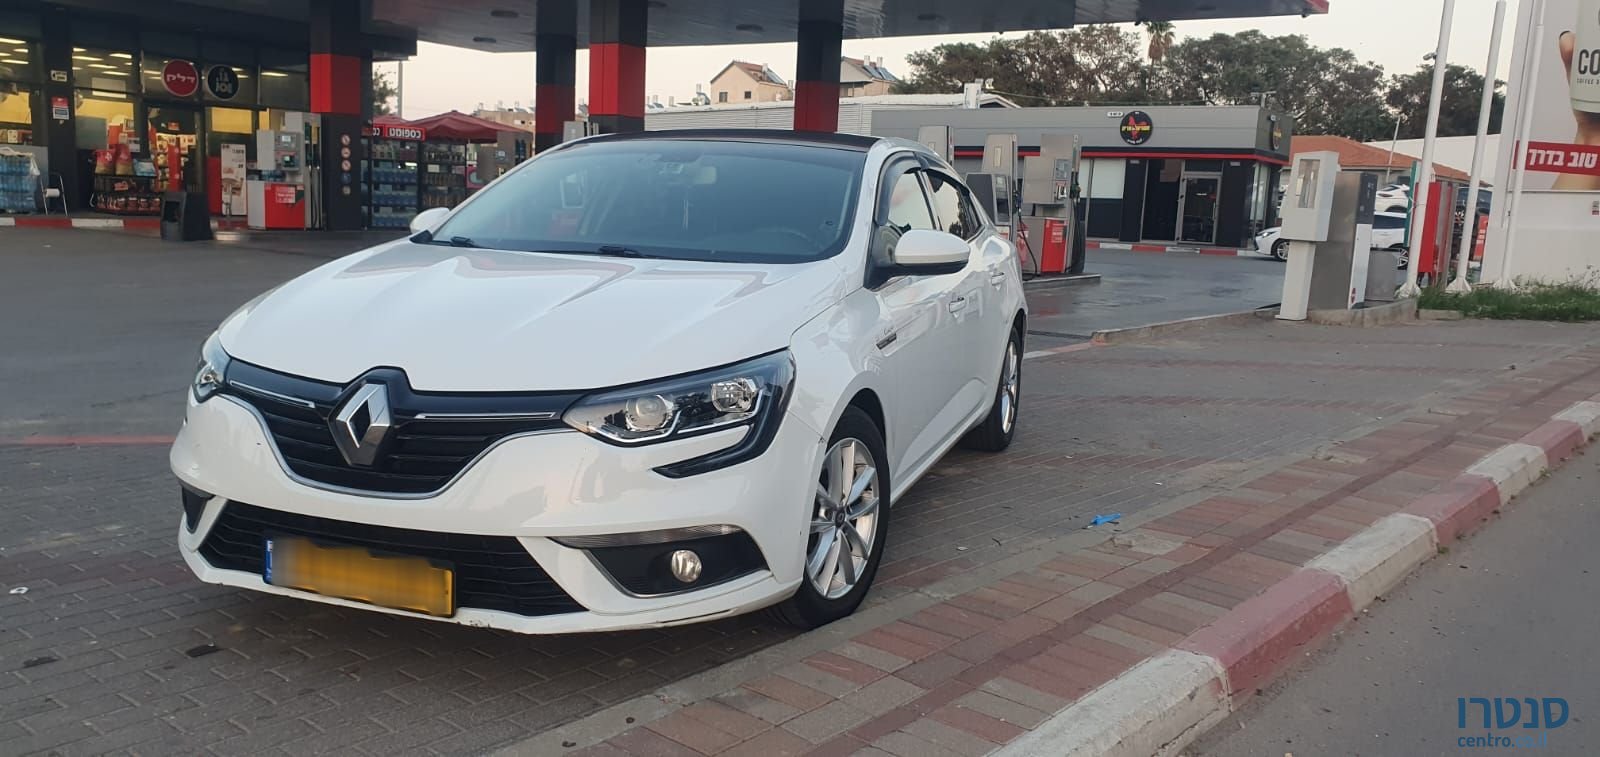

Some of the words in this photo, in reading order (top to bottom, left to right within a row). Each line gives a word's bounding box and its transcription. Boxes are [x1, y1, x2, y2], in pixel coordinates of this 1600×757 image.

[166, 73, 196, 84] דלק
[389, 127, 421, 138] כספומט
[1528, 148, 1565, 167] בדרך
[1567, 151, 1598, 169] טוב
